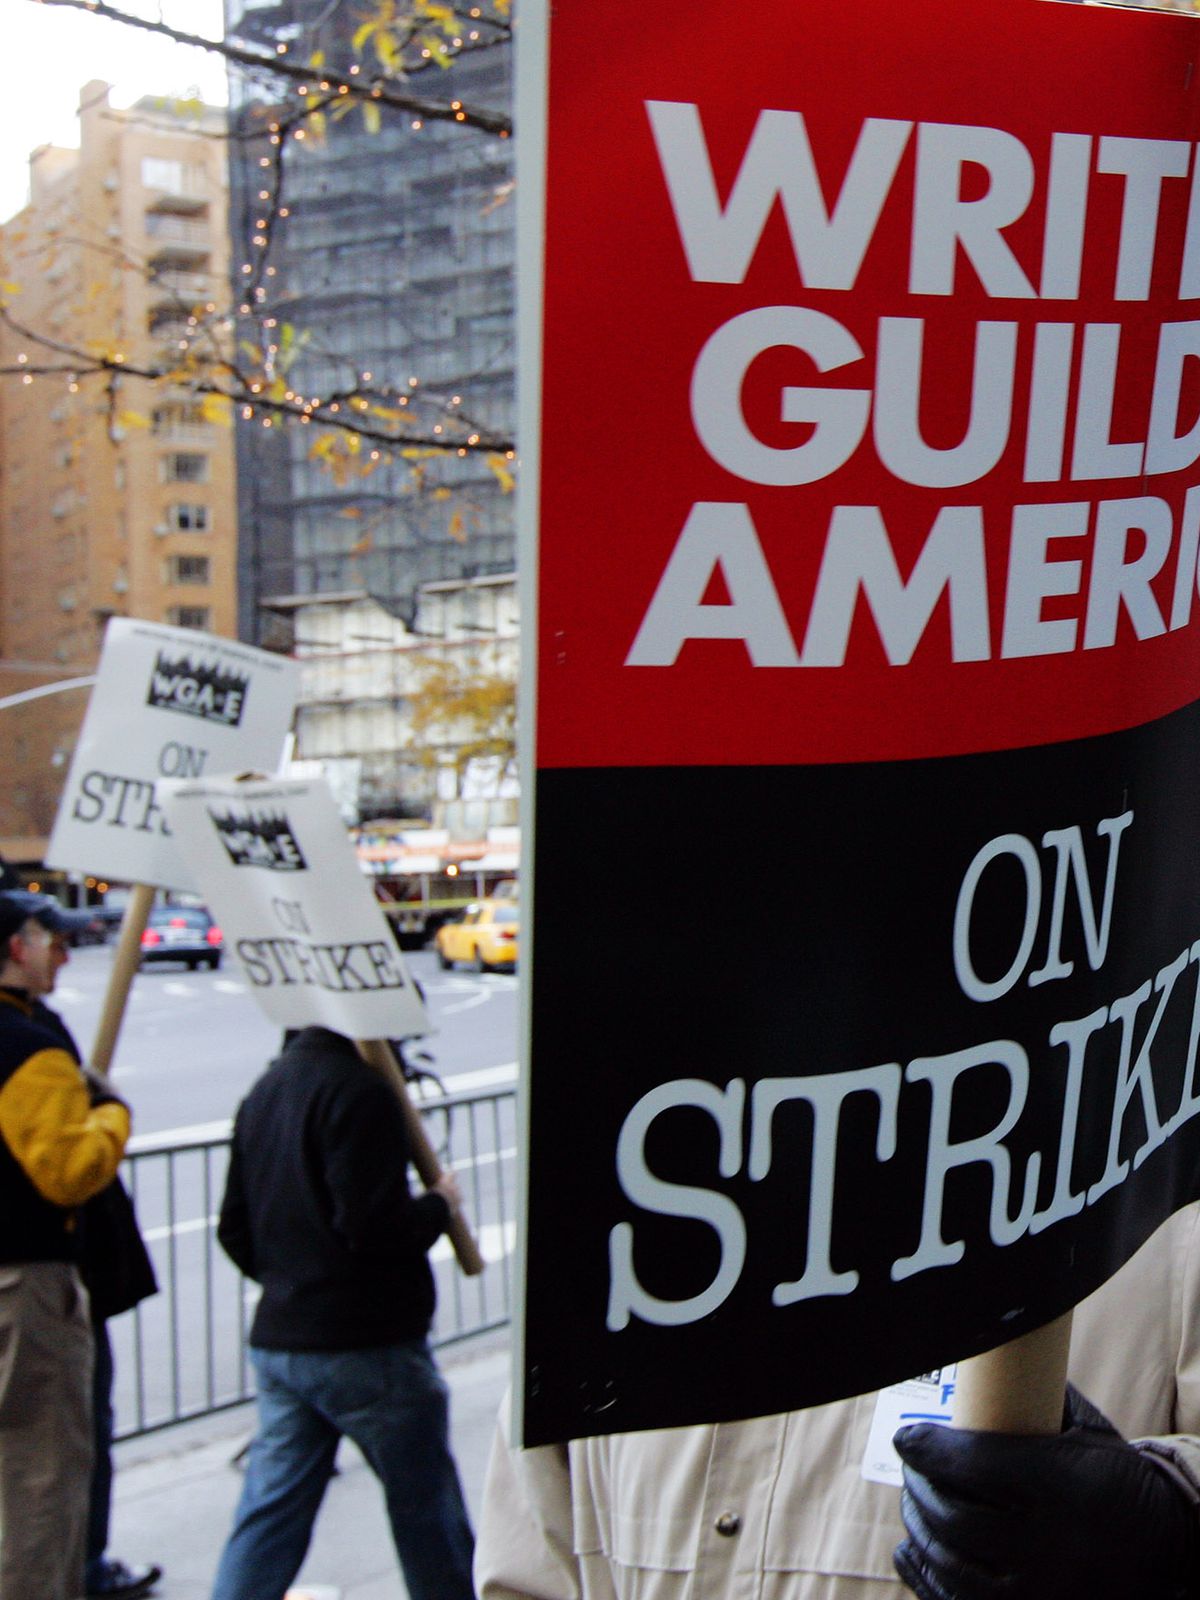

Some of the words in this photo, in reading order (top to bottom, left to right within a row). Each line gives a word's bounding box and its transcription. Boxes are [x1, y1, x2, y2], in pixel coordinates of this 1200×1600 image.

[158, 741, 209, 778] ON
[953, 810, 1133, 1002] ON
[236, 937, 405, 992] STRIKE
